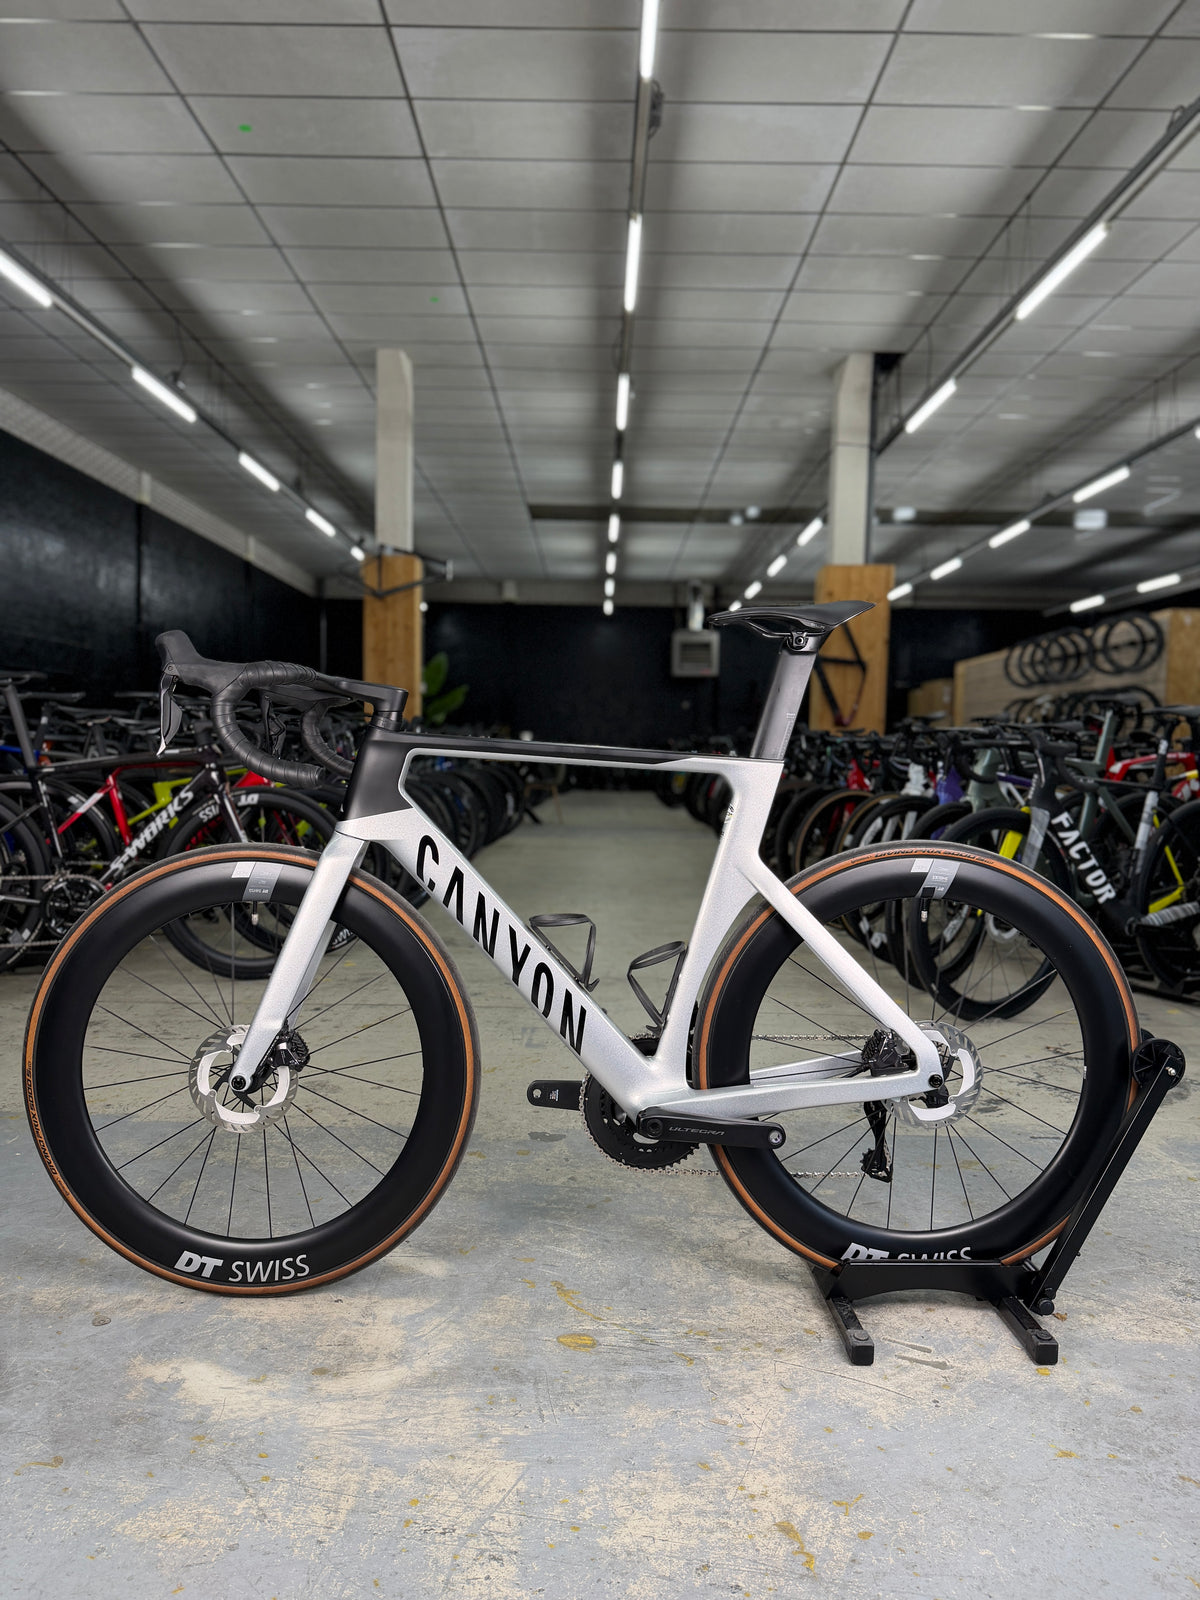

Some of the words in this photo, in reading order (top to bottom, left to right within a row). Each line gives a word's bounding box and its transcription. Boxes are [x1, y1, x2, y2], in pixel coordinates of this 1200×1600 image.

[237, 793, 260, 806] DT
[109, 791, 193, 878] S-WORKS
[1051, 811, 1116, 904] FACTOR
[416, 835, 586, 1056] CANYON
[669, 1126, 725, 1135] ULTEGRA
[174, 1250, 223, 1278] DT
[229, 1255, 309, 1283] SWISS
